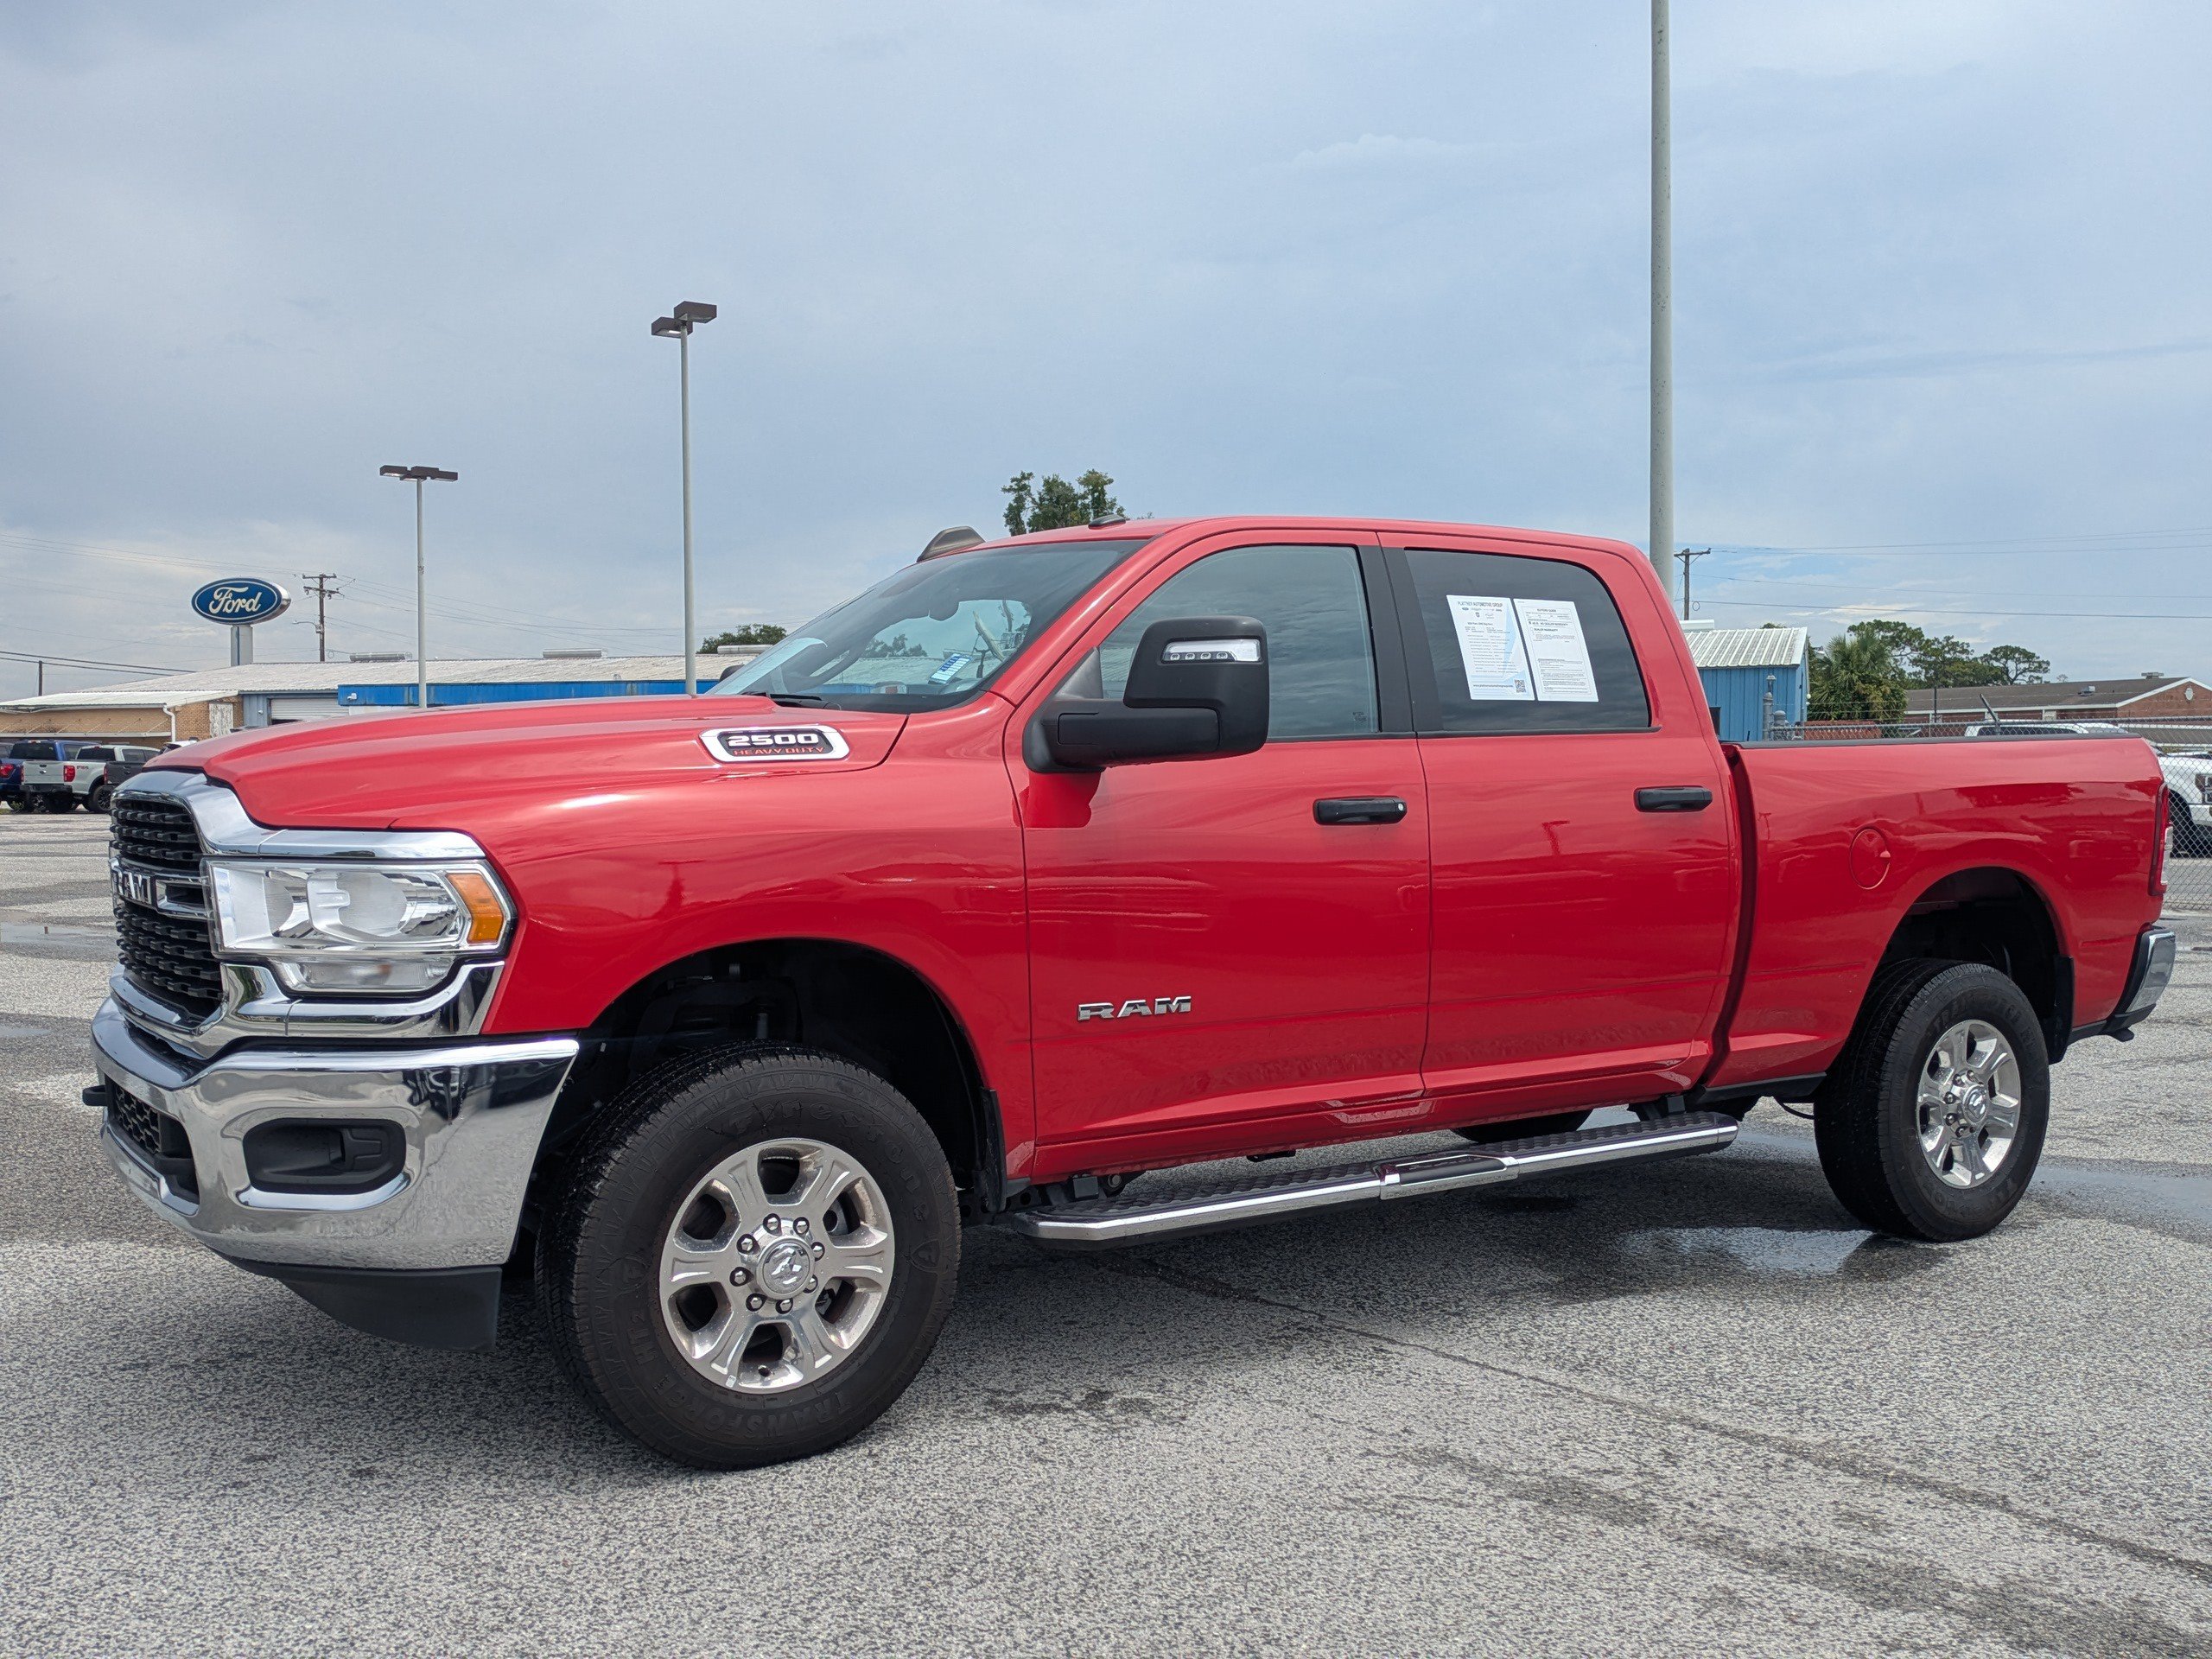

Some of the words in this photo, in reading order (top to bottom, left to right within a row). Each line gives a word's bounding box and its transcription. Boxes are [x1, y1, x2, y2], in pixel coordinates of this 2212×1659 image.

[208, 587, 263, 614] Ford
[726, 733, 819, 747] 2500
[734, 747, 784, 756] HEAVY
[1077, 995, 1192, 1021] RAM
